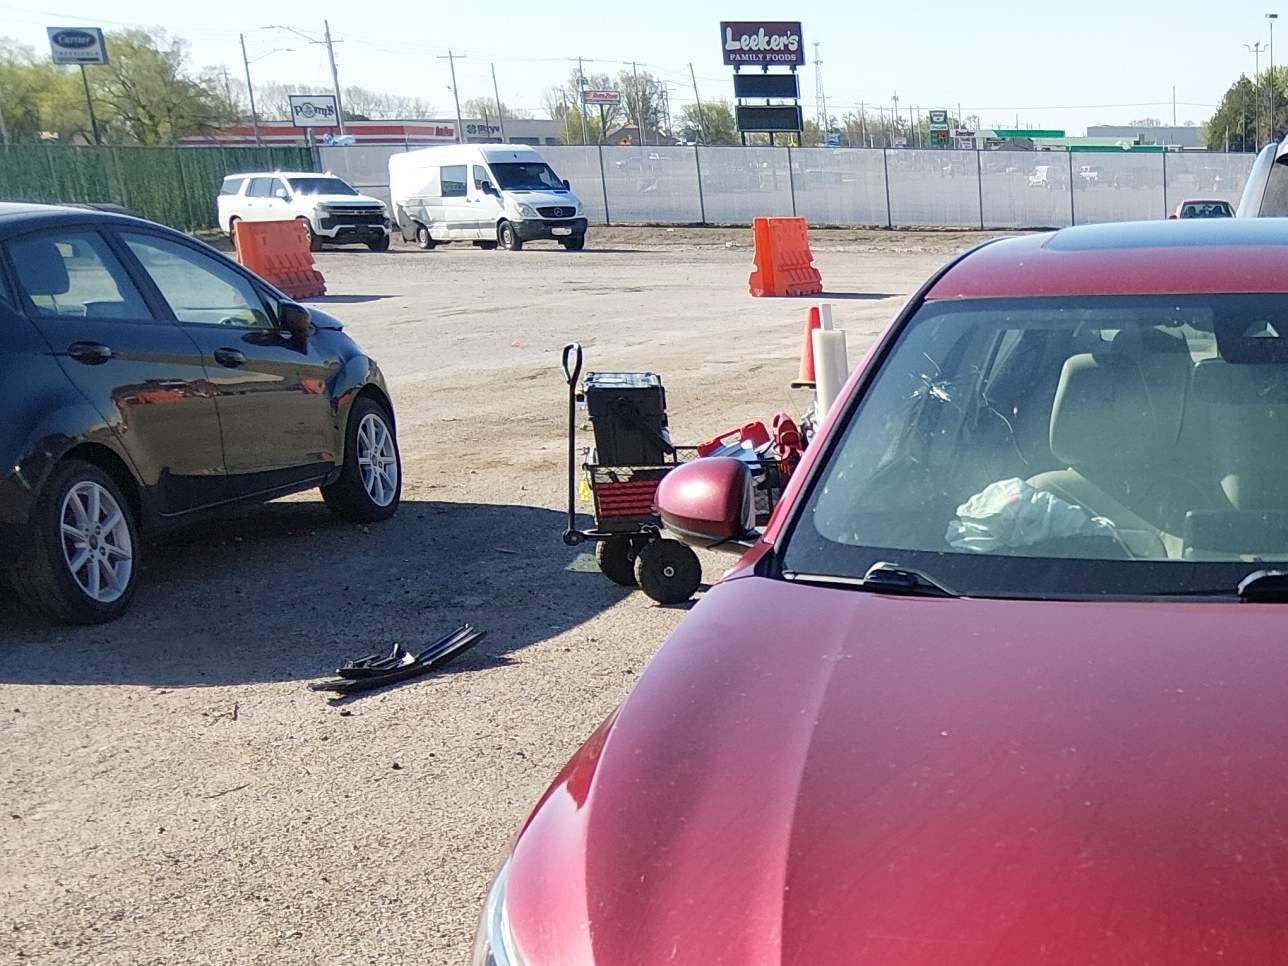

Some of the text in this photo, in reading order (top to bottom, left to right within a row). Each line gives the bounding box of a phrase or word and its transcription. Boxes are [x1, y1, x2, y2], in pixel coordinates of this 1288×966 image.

[725, 27, 799, 51] Leeker's
[730, 53, 797, 61] FAMILY FOODS
